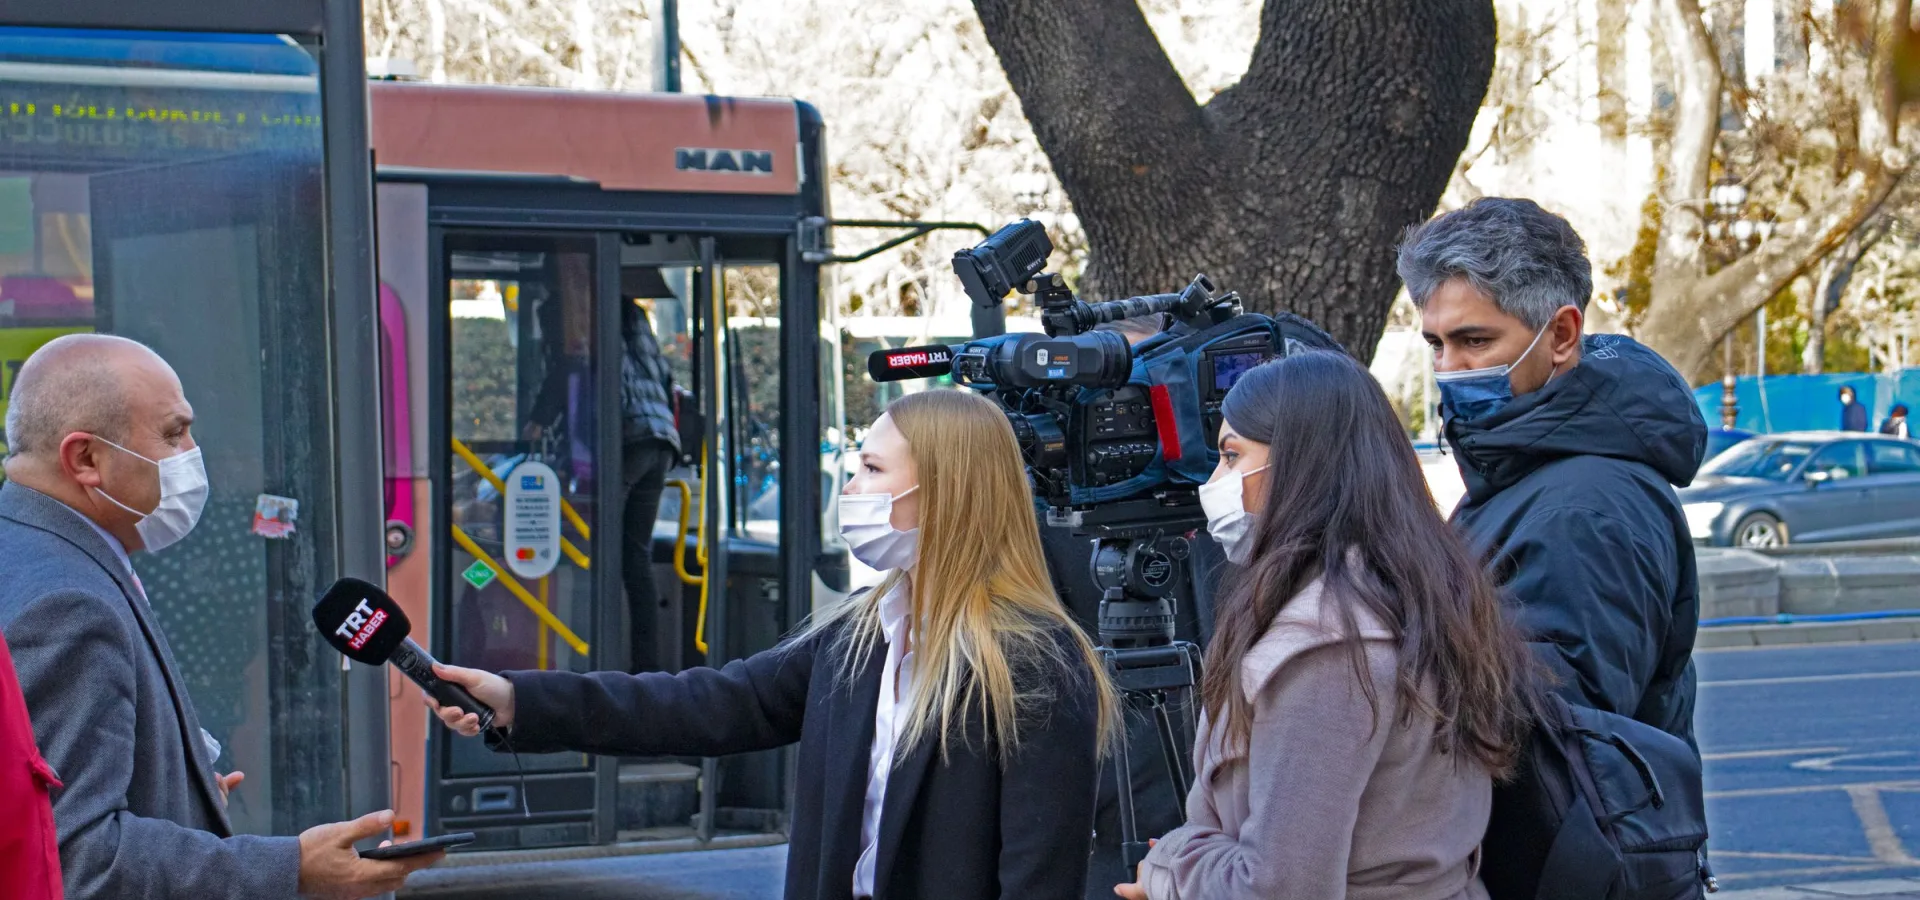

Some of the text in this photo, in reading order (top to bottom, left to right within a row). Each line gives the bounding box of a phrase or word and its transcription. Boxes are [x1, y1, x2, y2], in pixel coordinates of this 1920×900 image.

[675, 147, 774, 174] MAN
[889, 351, 950, 367] TRT HABER
[335, 598, 375, 640] TRT
[351, 610, 388, 649] HABER
